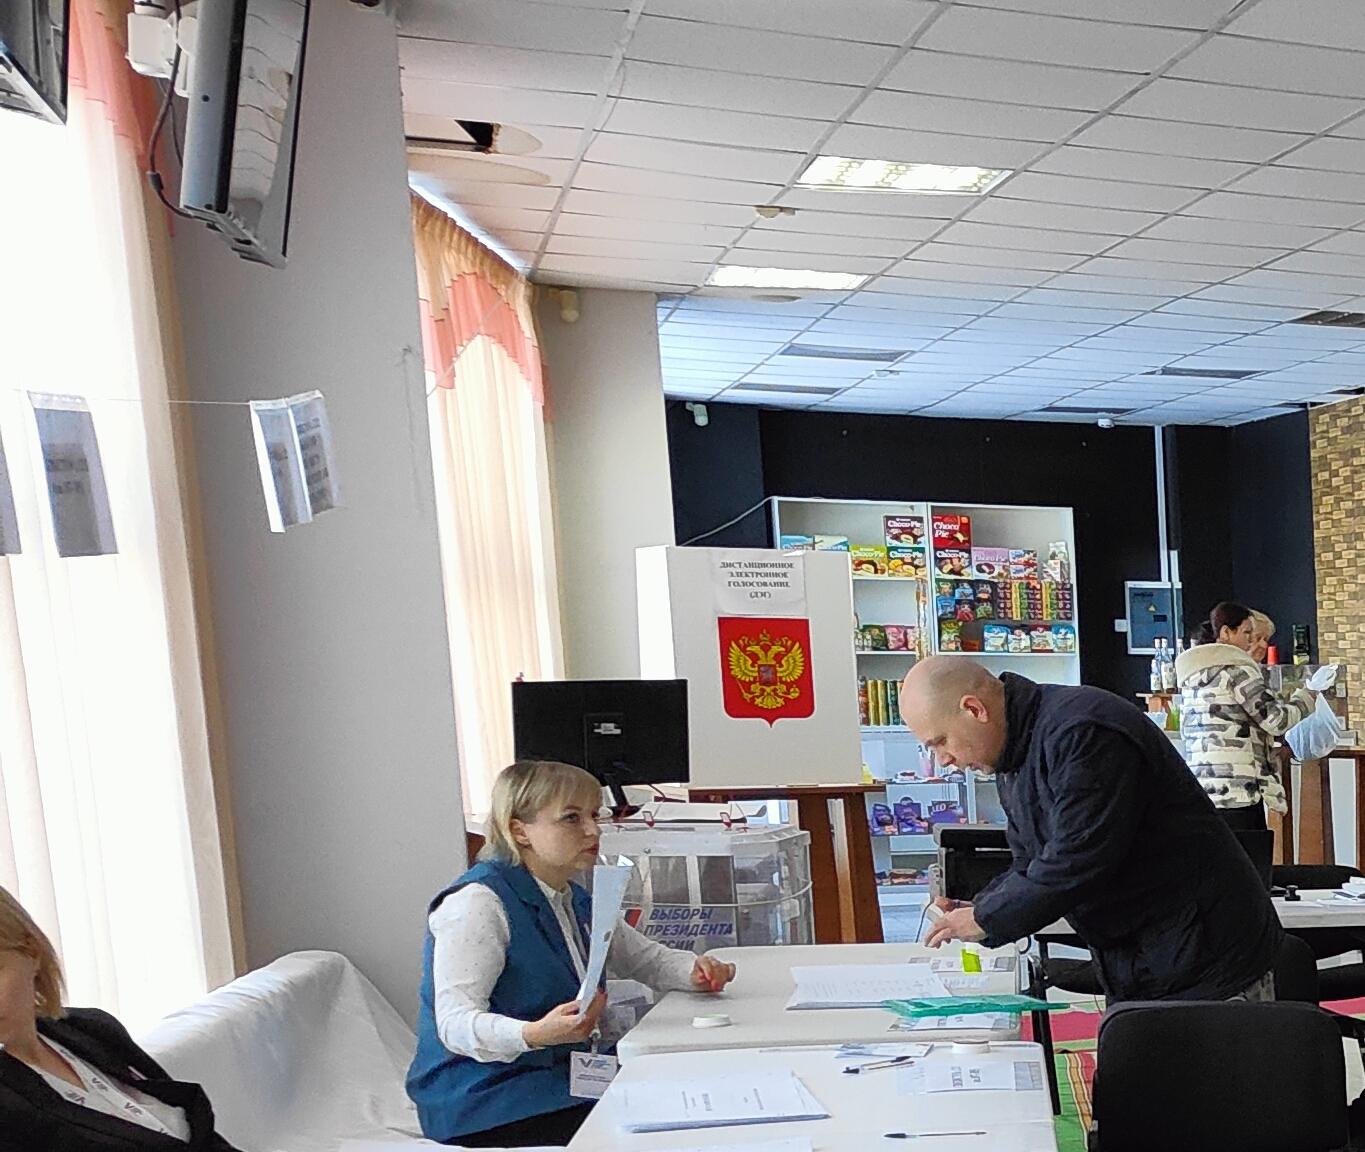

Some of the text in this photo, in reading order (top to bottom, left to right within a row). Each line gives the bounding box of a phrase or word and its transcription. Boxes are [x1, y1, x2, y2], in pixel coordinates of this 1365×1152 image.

[719, 561, 795, 569] ДИСТАНЦИОННОЕ
[728, 571, 789, 579] ЭЛЕКТРОННОЕ
[649, 908, 713, 920] ВЫБОРЫ
[643, 923, 733, 937] ПРЕЗИДЕНТА
